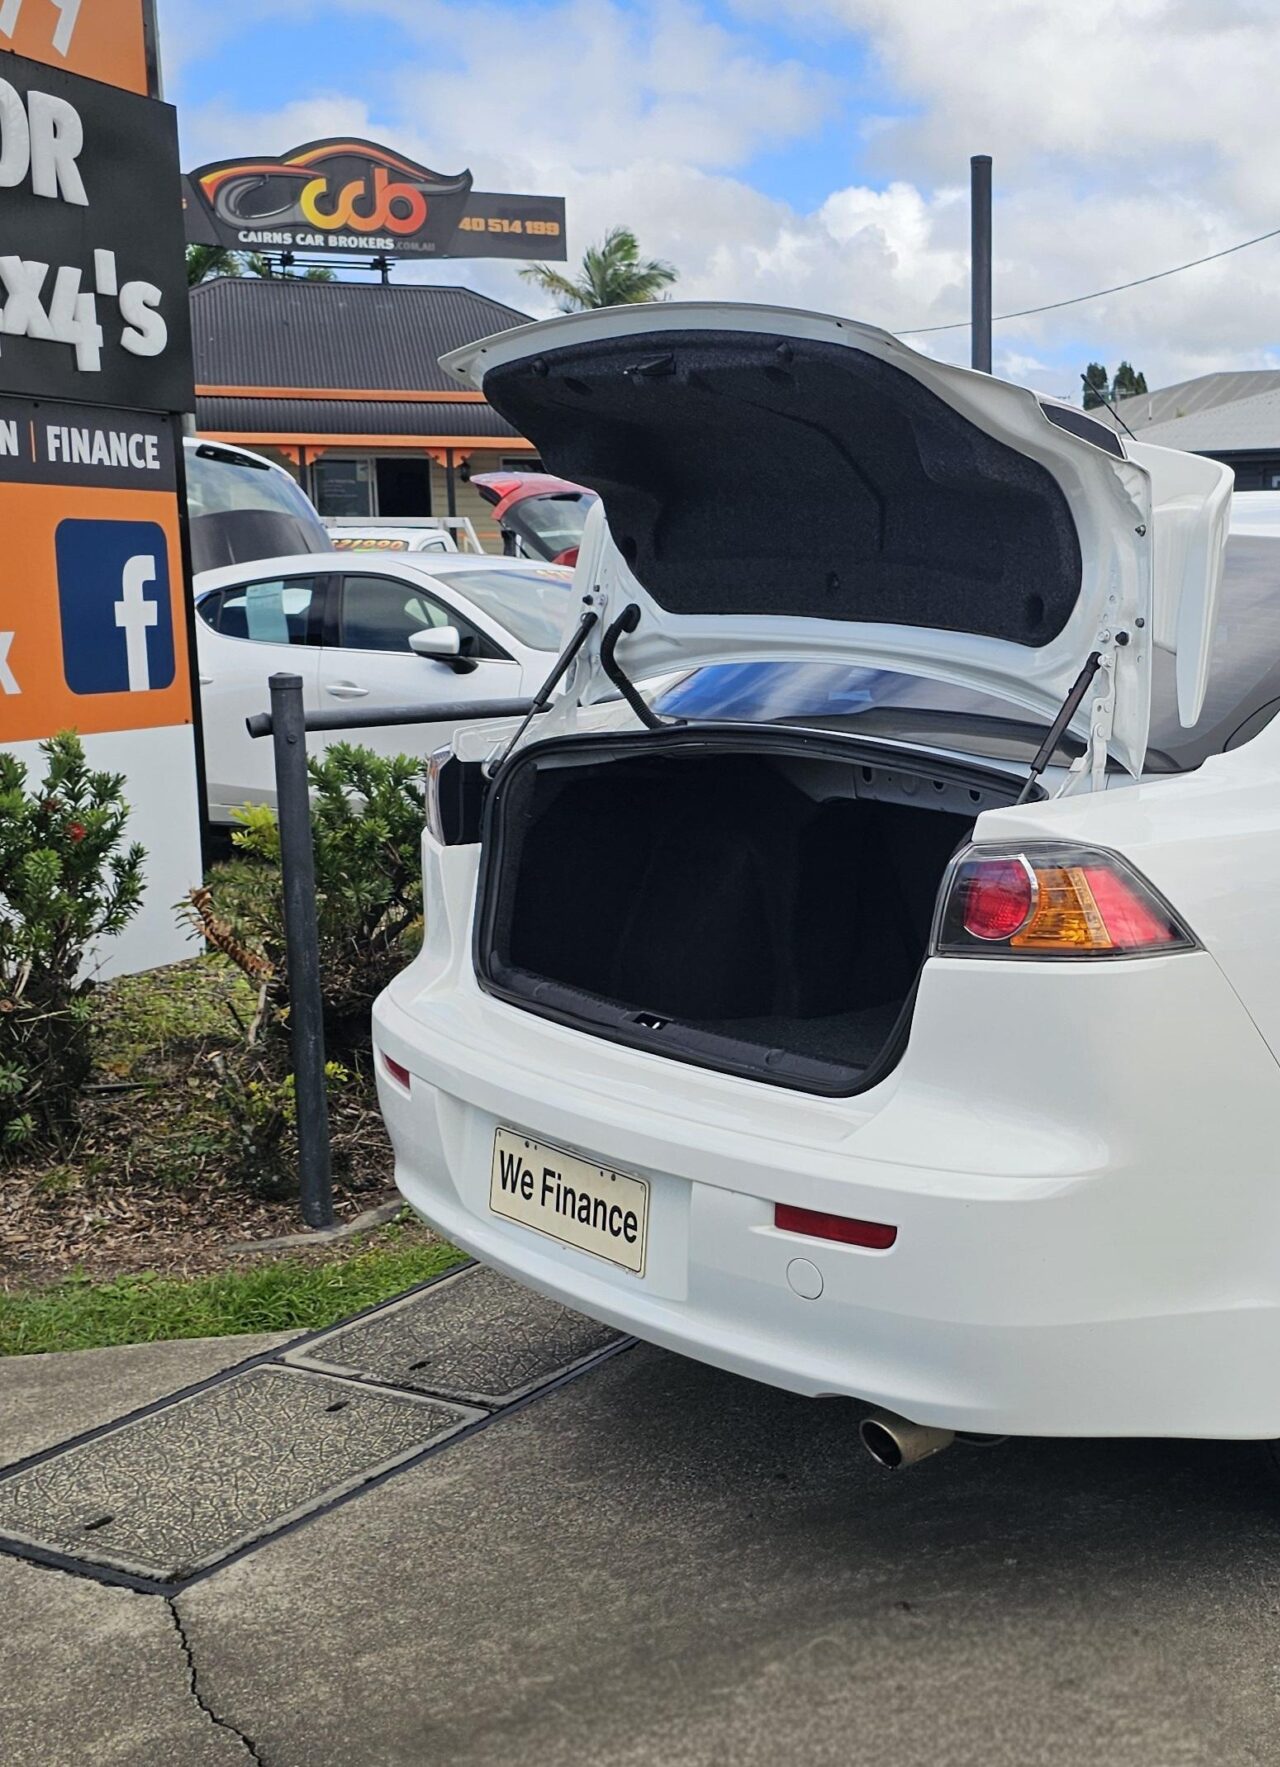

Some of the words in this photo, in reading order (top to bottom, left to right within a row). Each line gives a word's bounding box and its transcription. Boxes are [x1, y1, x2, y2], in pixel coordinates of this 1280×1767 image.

[238, 230, 293, 245] CAIRNS
[295, 233, 325, 247] CAR
[328, 235, 395, 250] BROKERS
[458, 217, 485, 231] 40
[488, 218, 523, 233] 514
[46, 424, 161, 470] FINANCE
[500, 1150, 534, 1201] We
[541, 1167, 638, 1244] Finance
